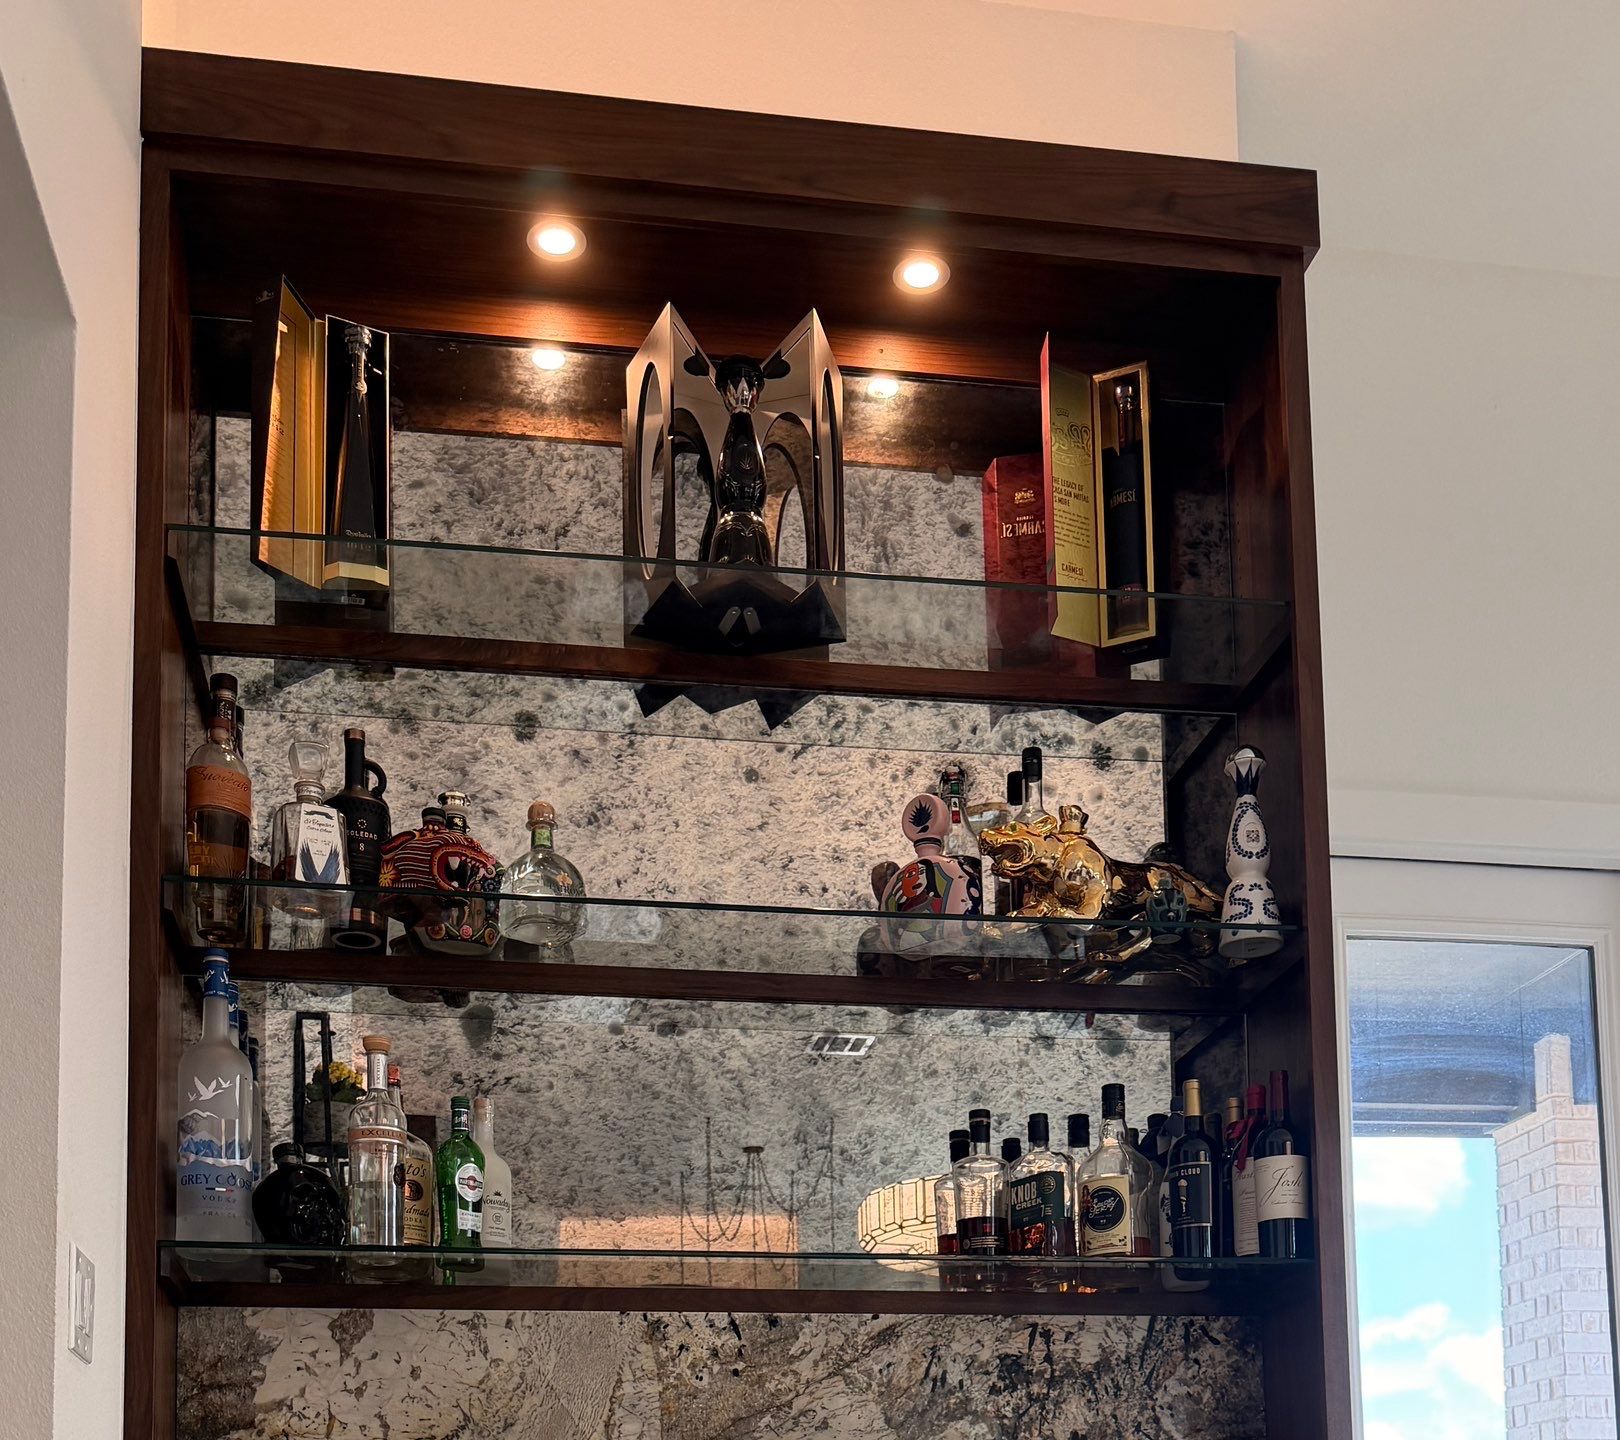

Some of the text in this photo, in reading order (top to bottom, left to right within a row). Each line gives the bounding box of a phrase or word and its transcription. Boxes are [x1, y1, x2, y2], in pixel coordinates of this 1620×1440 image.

[1180, 1167, 1201, 1176] CLOUD
[181, 1174, 211, 1186] GREY
[1260, 1165, 1304, 1208] Josh
[1011, 1181, 1037, 1205] KNOB
[1016, 1197, 1043, 1210] CREEK
[404, 1216, 423, 1224] ODKA
